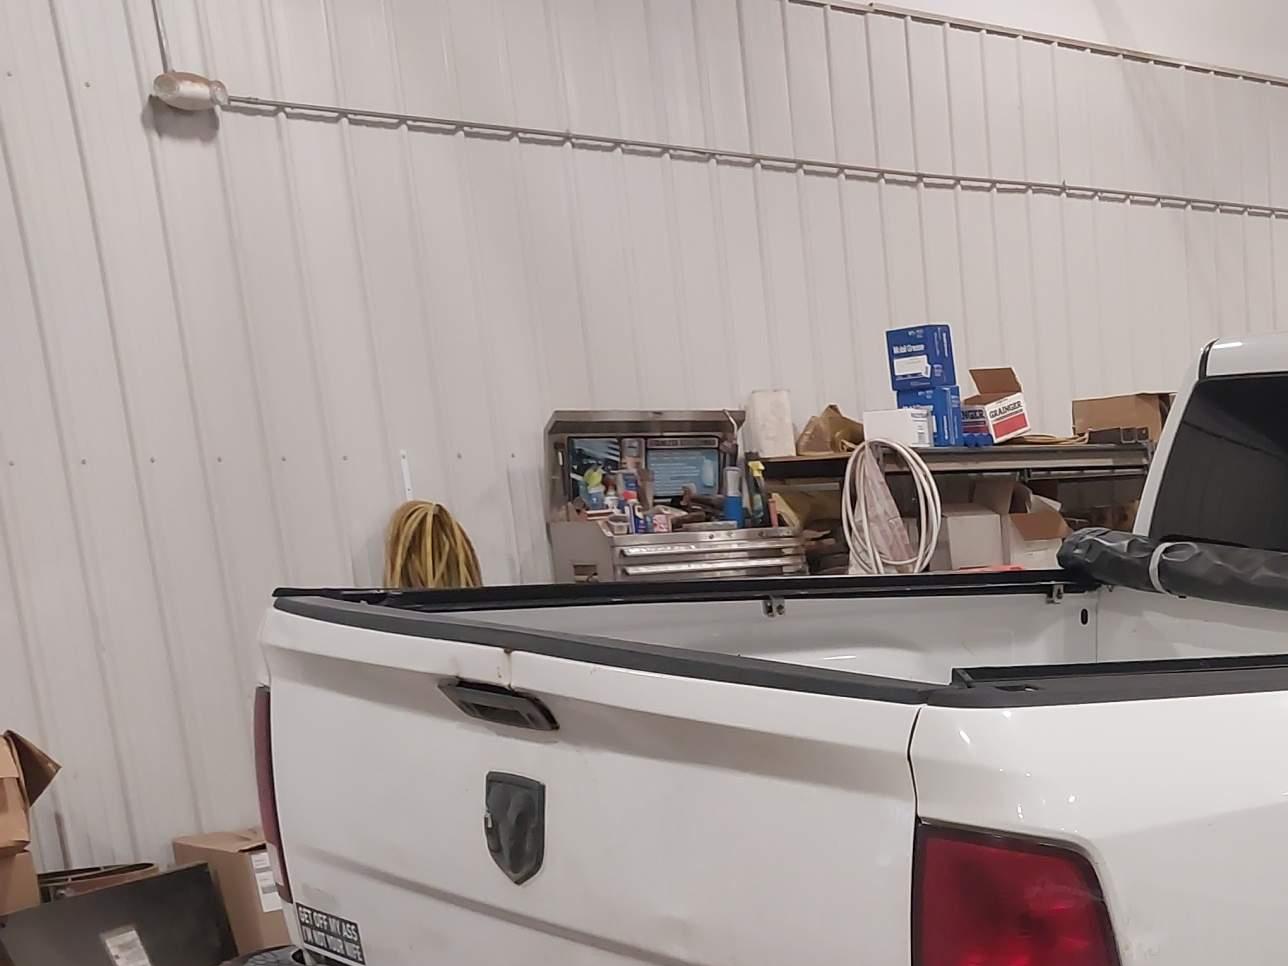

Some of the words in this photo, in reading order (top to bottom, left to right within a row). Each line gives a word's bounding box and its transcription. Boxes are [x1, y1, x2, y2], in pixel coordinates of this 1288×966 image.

[961, 410, 985, 419] NGER
[989, 400, 1022, 419] GRAINGER
[299, 906, 312, 926] GET
[313, 911, 328, 930] OFF
[328, 916, 341, 936] MY
[342, 921, 358, 941] ASS
[313, 929, 328, 949] NOT
[327, 934, 346, 956] YOUR
[345, 940, 363, 962] WIFE
